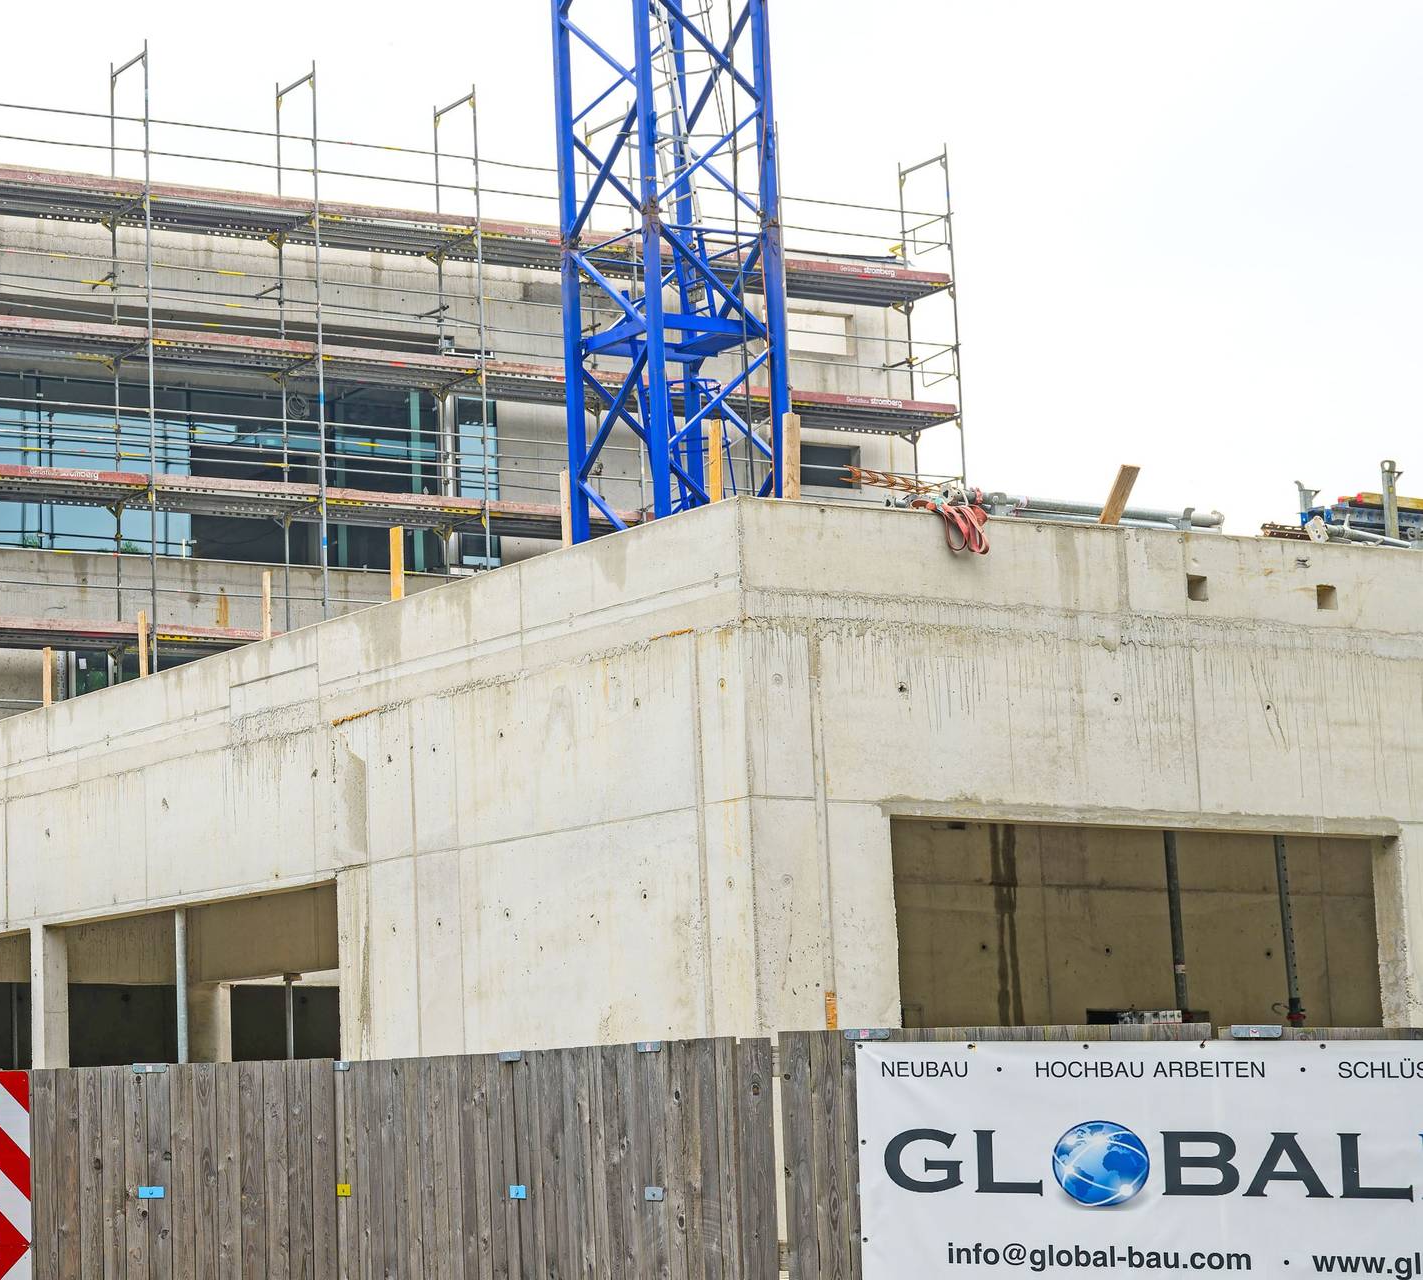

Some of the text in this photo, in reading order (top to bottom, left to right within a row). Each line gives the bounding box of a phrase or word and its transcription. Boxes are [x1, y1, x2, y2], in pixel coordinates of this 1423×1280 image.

[863, 266, 896, 277] stromberg
[870, 397, 903, 409] stromberg
[881, 1061, 968, 1078] NEUBAU
[1035, 1061, 1144, 1078] HOCHBAU
[1153, 1061, 1265, 1078] ARBEITEN
[948, 1242, 1421, 1280] info@global-bau.com www.gl
